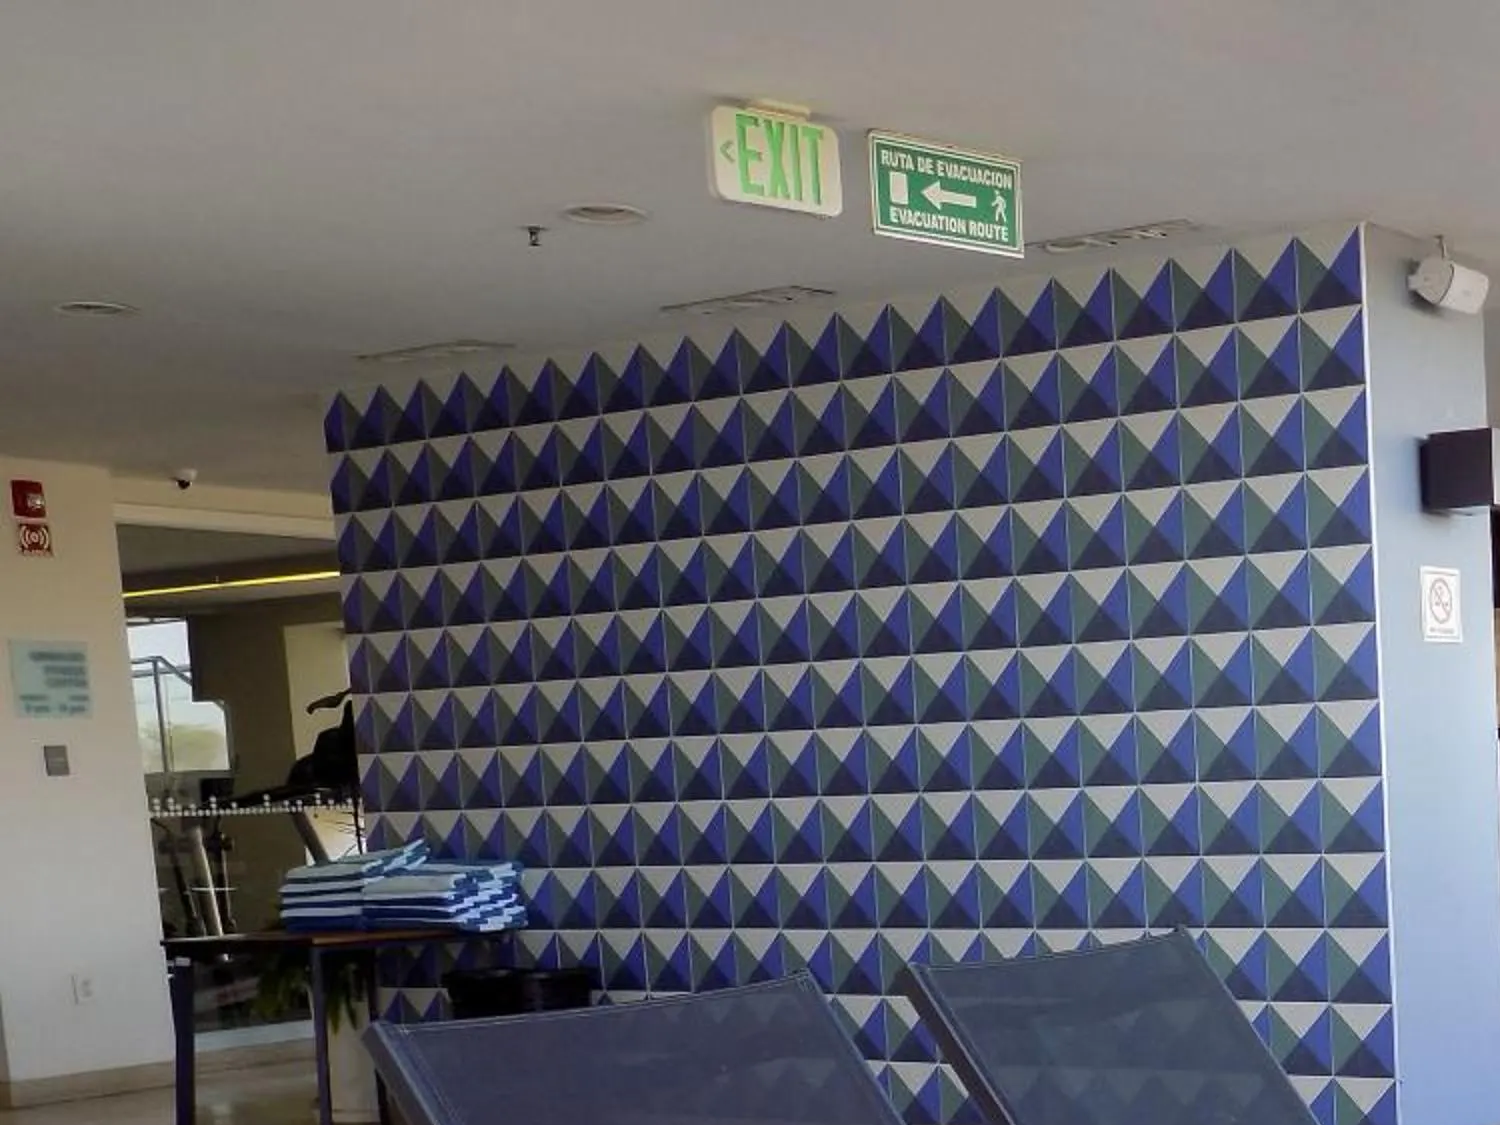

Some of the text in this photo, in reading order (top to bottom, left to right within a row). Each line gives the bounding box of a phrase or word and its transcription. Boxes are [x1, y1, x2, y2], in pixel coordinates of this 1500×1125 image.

[735, 113, 823, 205] EXIT
[881, 149, 914, 171] RUTA
[917, 156, 934, 175] DE
[889, 205, 1009, 242] EVACUATION ROUTE
